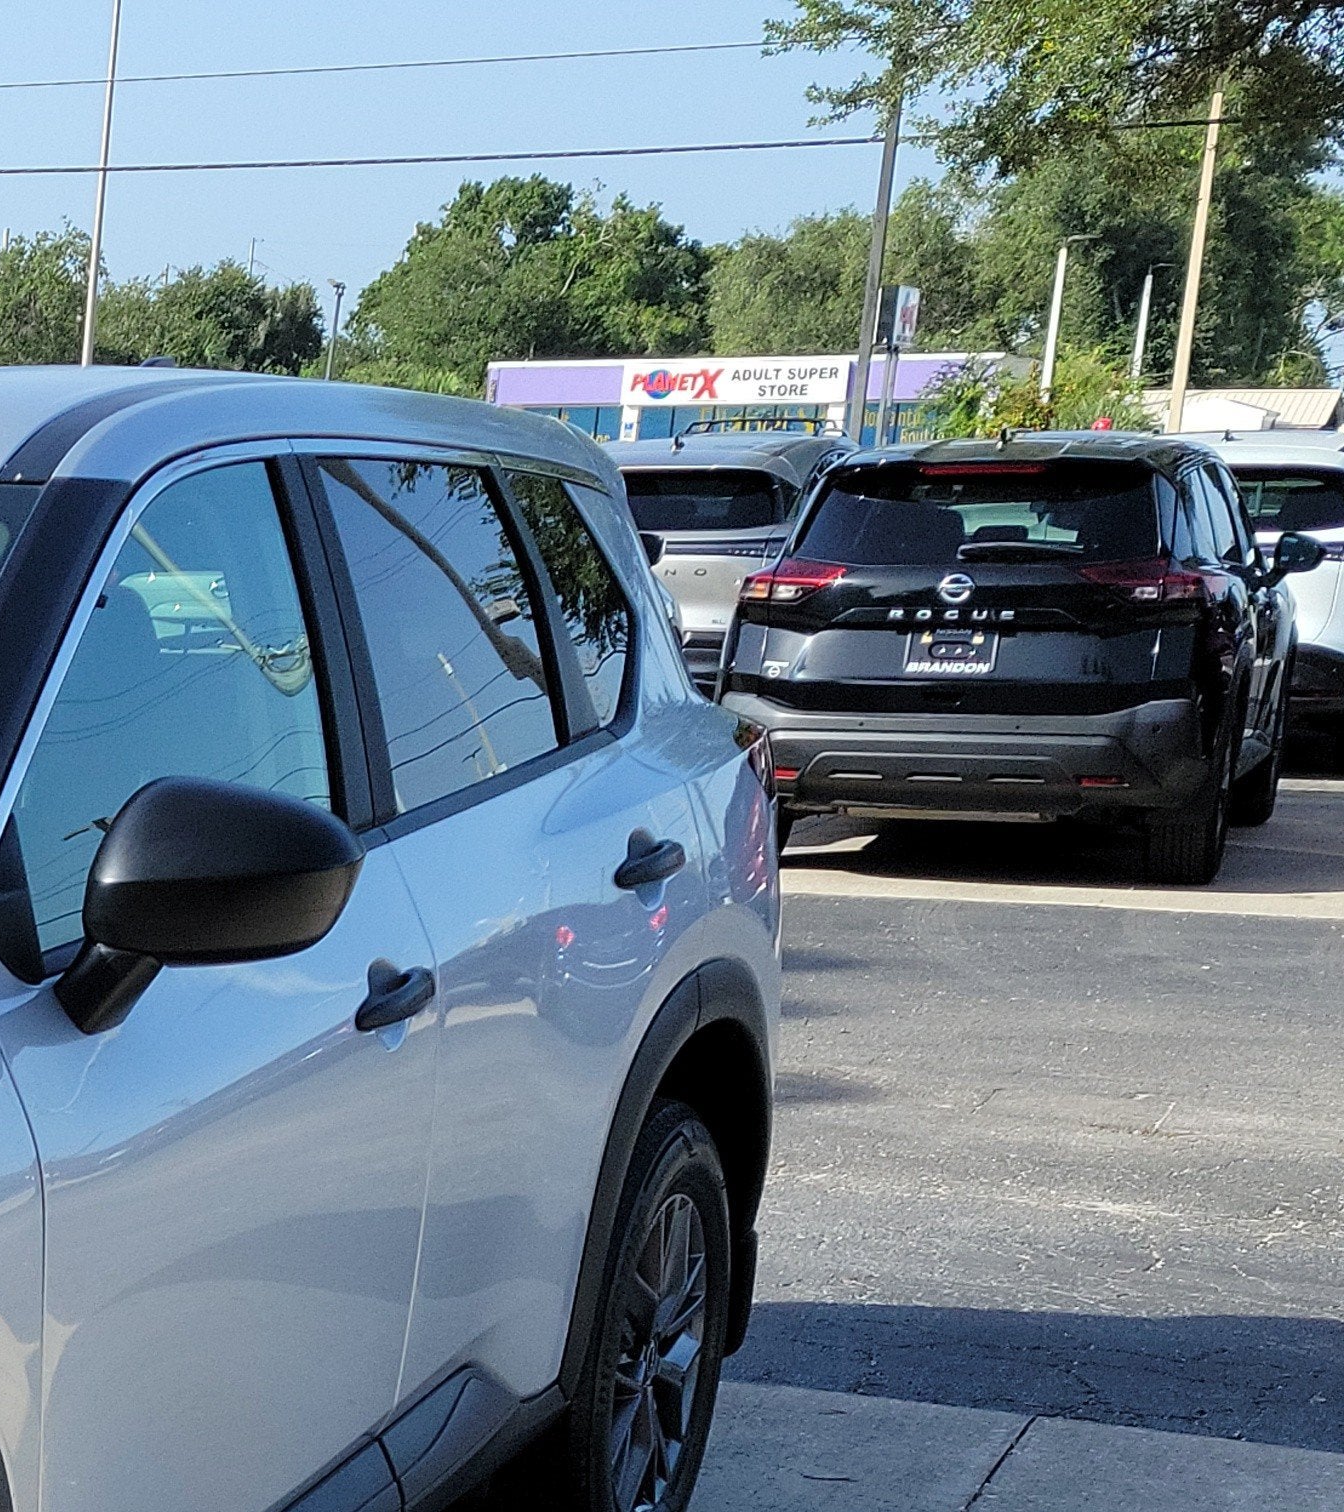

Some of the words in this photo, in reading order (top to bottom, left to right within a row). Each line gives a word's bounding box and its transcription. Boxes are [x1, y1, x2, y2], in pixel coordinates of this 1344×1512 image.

[731, 368, 782, 381] ADULT
[787, 367, 839, 380] SUPER
[758, 384, 808, 397] STORE
[887, 609, 1016, 622] ROGUE
[904, 661, 991, 674] BRANDON
